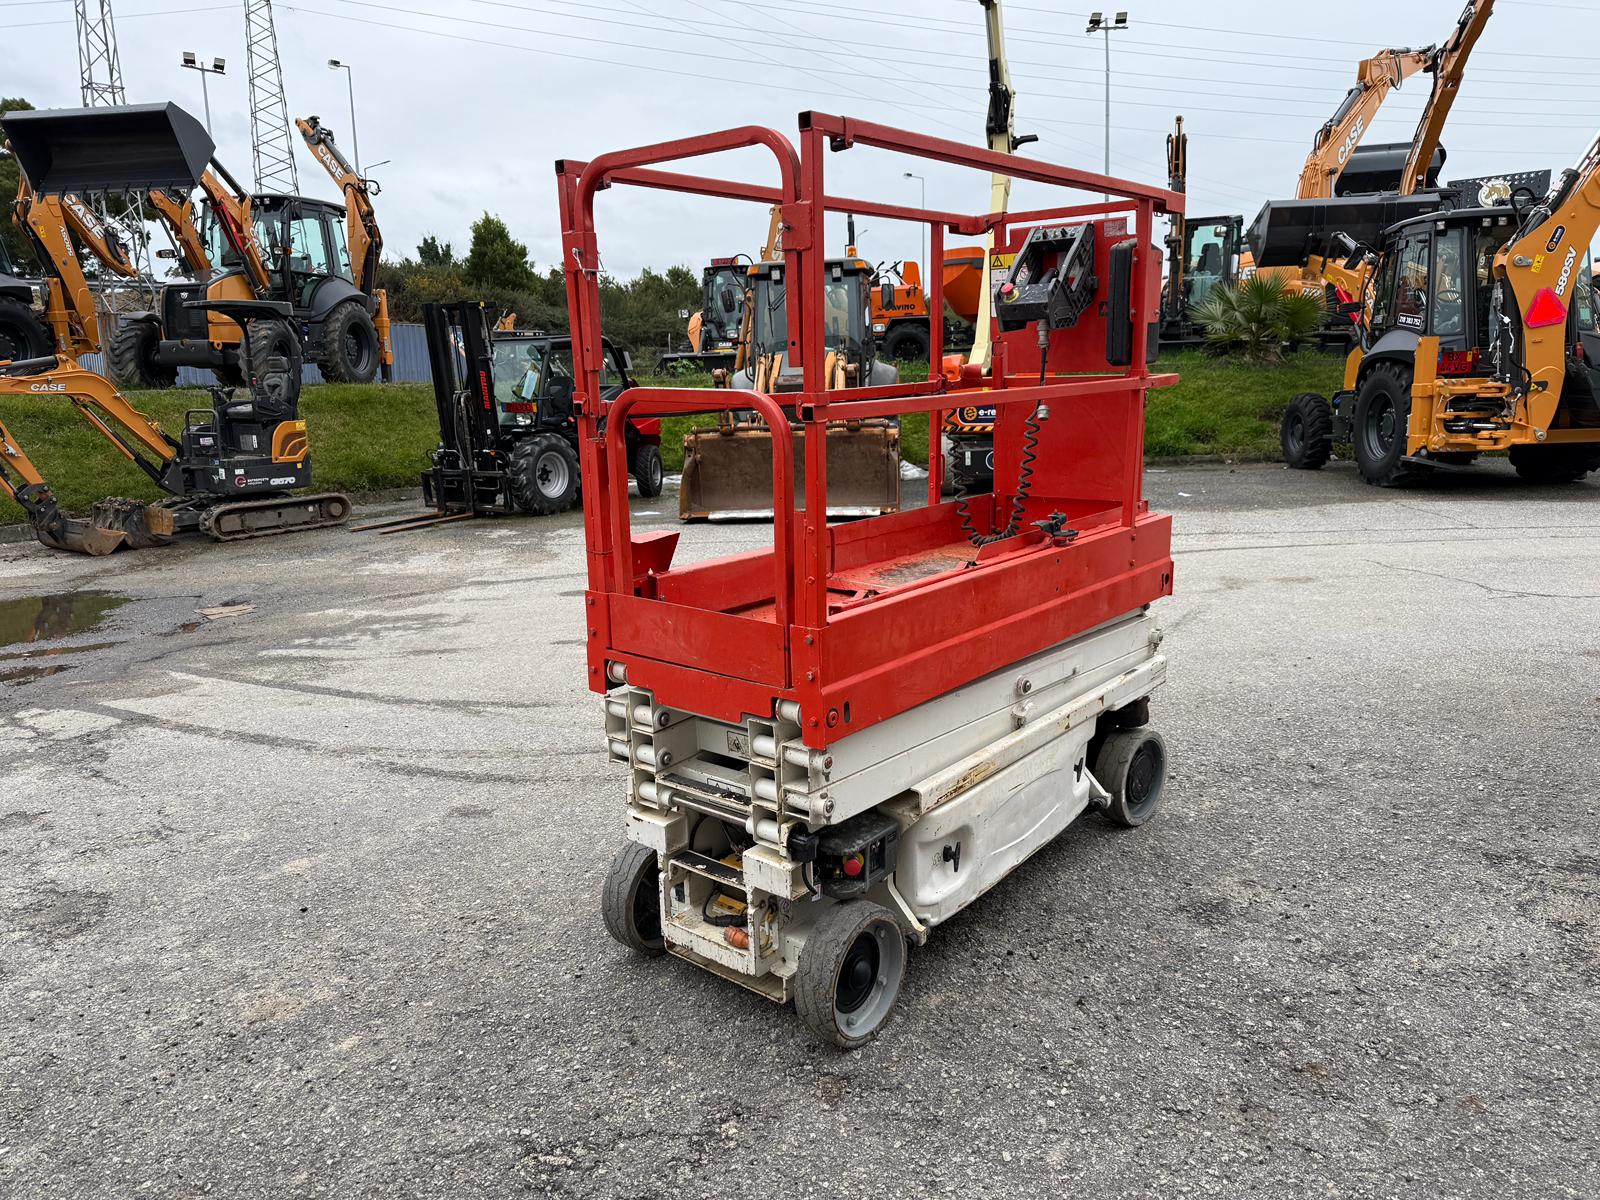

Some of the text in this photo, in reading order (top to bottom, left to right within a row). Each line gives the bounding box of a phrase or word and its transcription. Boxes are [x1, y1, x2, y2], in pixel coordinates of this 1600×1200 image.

[1338, 115, 1364, 164] CASE
[318, 144, 344, 180] CASE
[63, 194, 105, 240] CASE
[1555, 245, 1577, 296] 580SV
[31, 383, 66, 391] CASE
[480, 368, 491, 409] MANITOU
